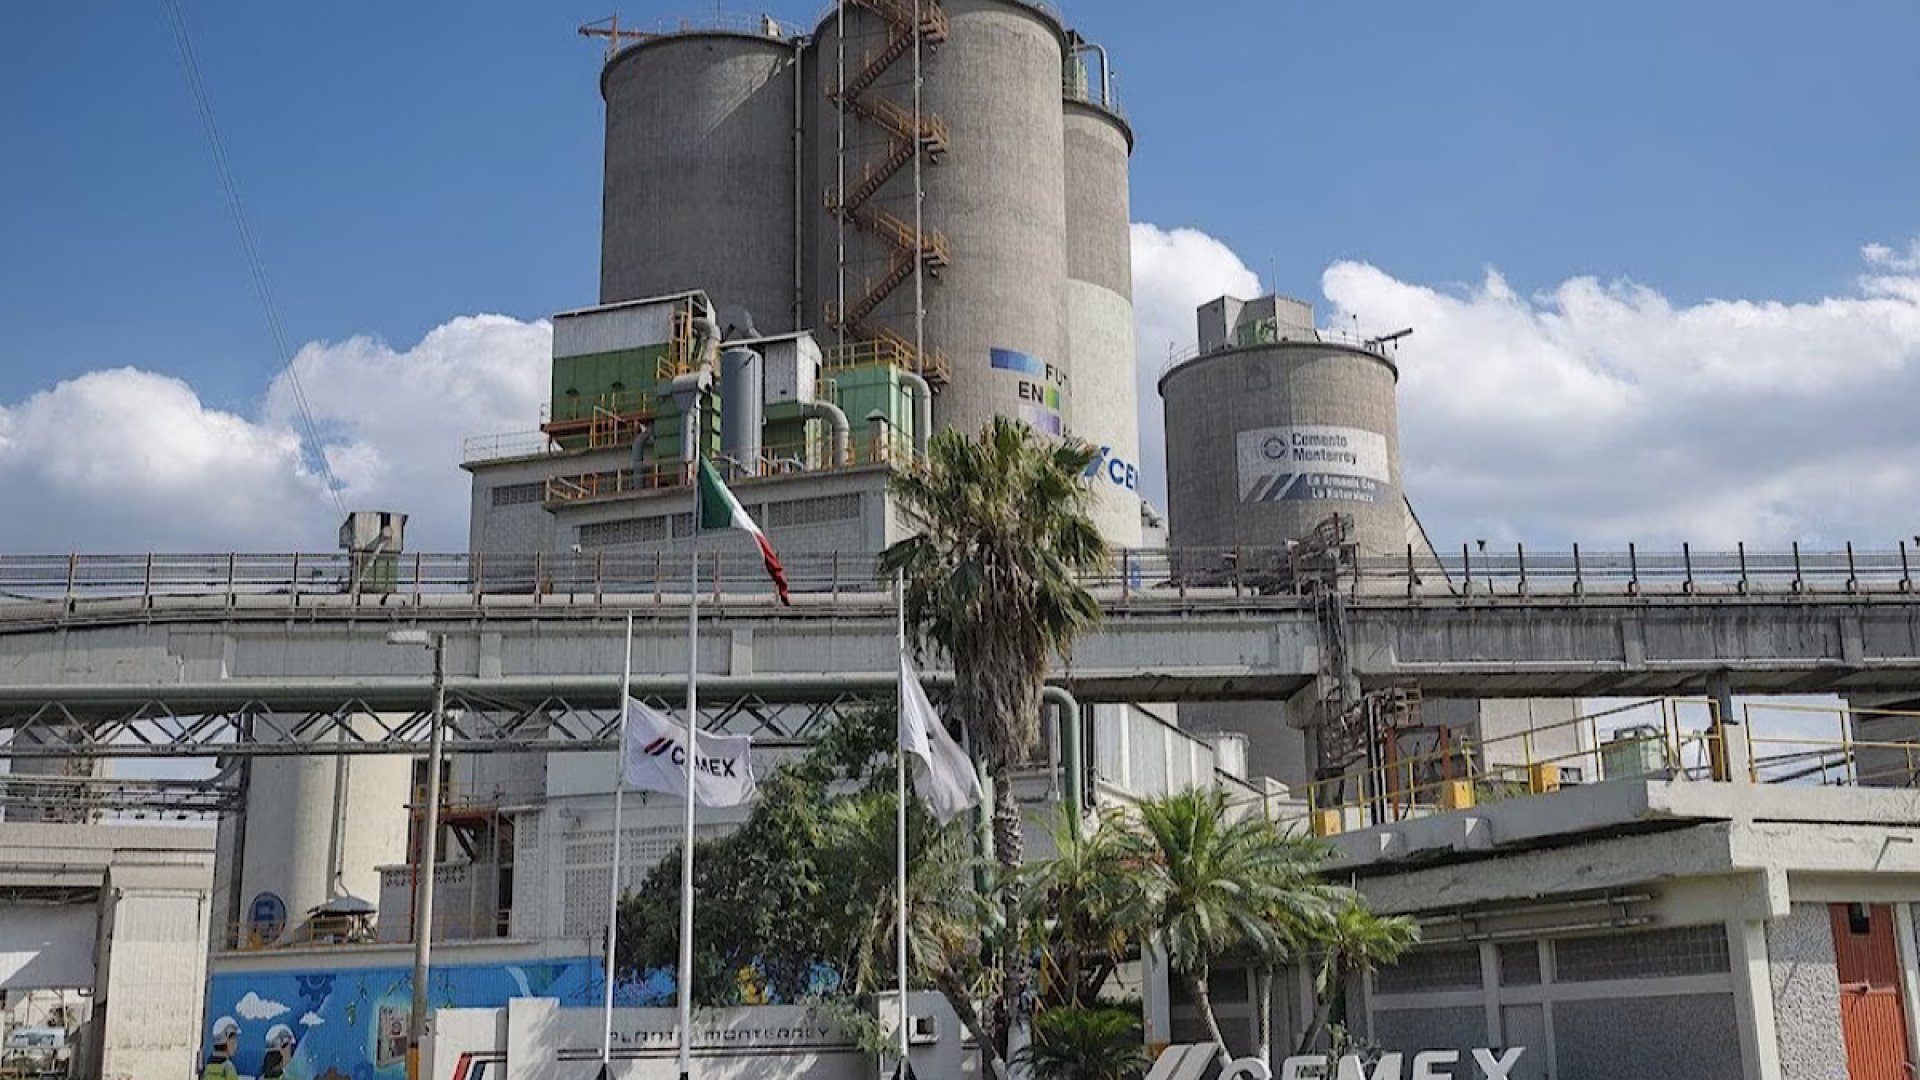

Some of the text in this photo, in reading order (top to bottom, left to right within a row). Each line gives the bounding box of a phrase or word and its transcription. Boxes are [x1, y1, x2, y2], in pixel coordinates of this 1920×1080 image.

[1019, 381, 1043, 403] EN
[1293, 448, 1357, 464] Monterrey
[1109, 458, 1138, 489] CE
[672, 746, 736, 777] CMEX
